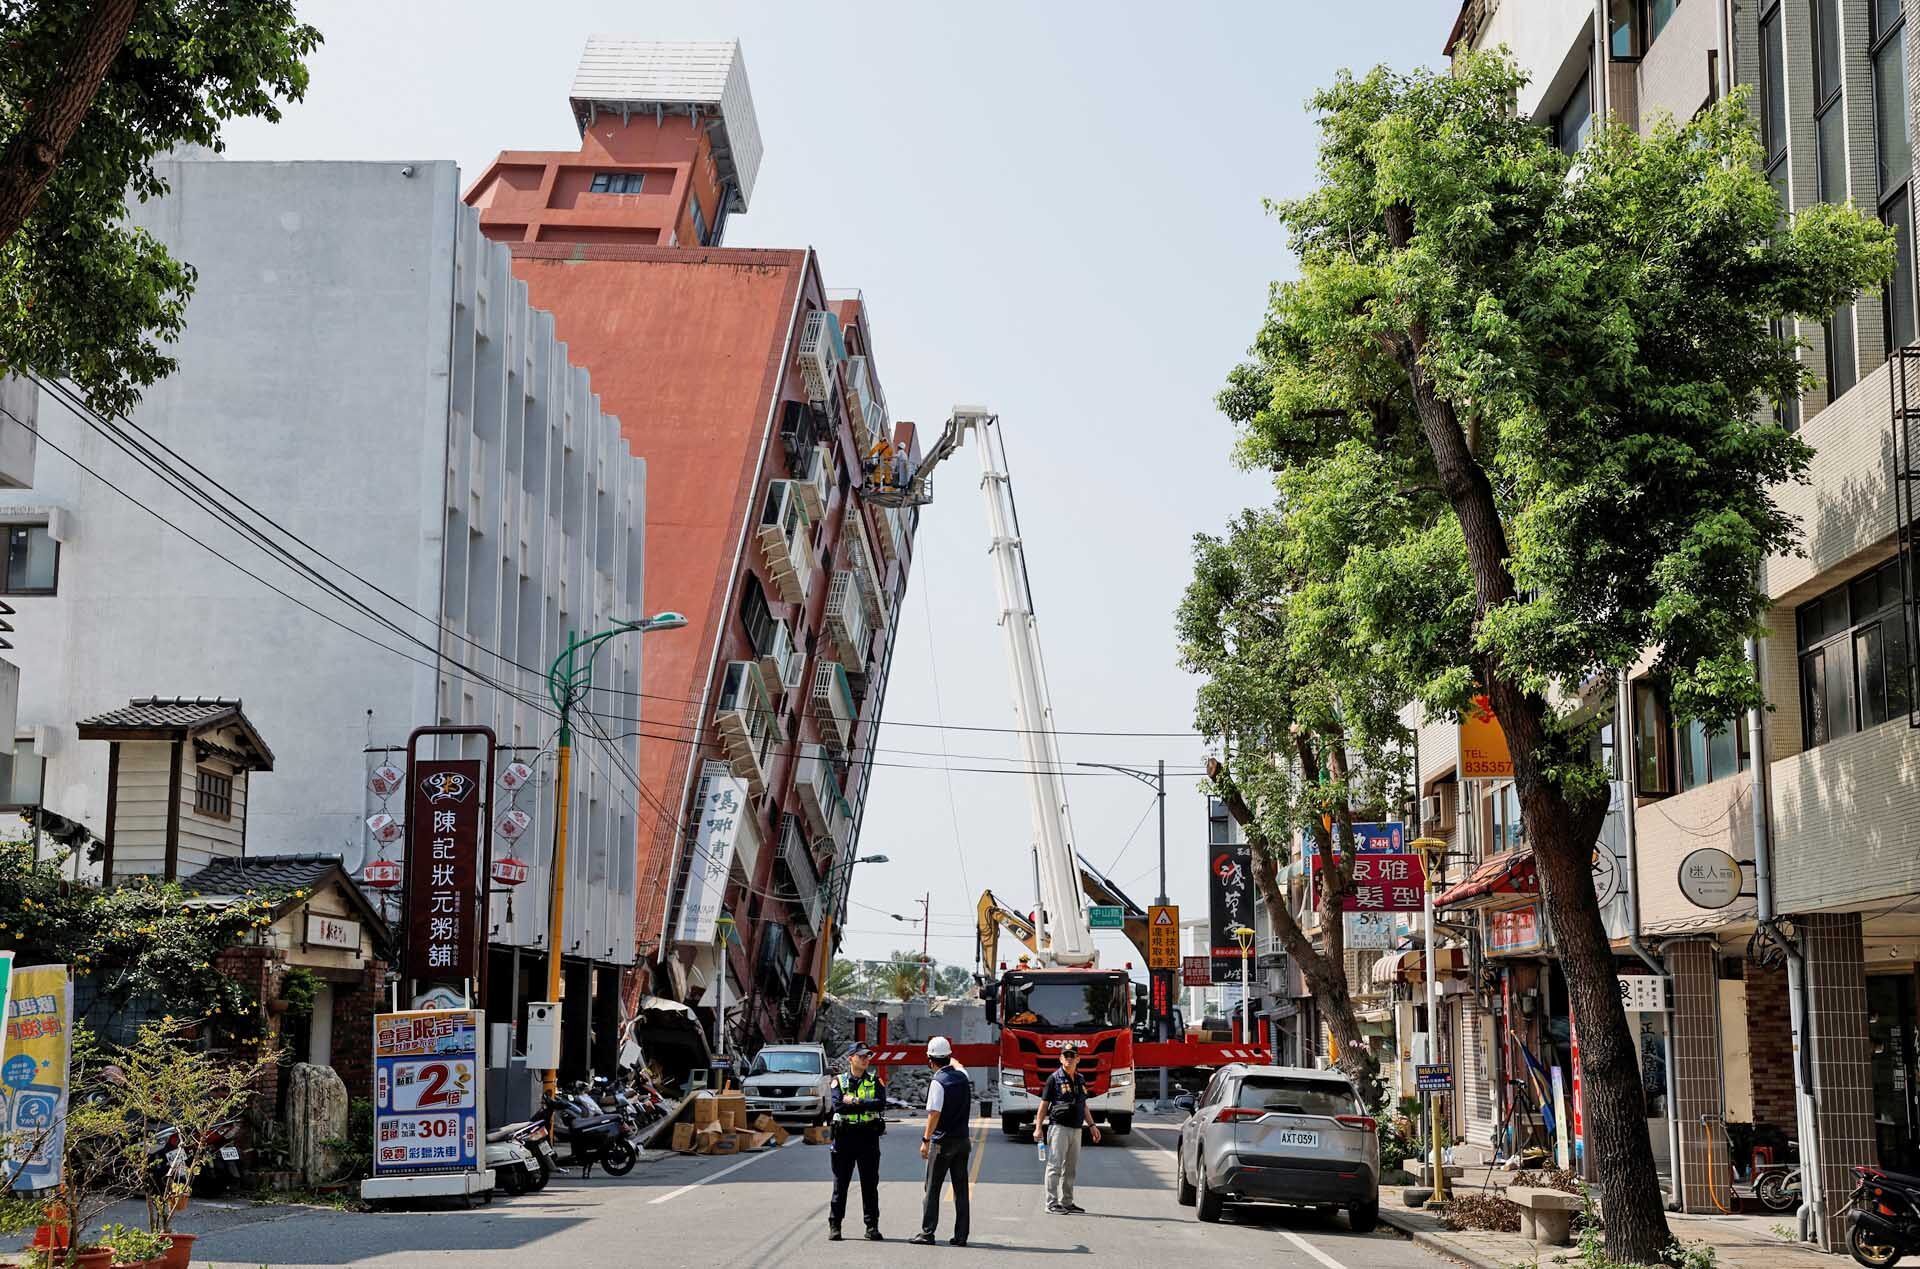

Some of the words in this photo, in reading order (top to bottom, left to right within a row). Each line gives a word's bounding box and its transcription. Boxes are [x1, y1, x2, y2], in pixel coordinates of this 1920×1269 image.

[1464, 750, 1488, 759] TEL:
[1371, 838, 1389, 848] 24H
[1355, 886, 1420, 908] 髮型
[418, 1119, 448, 1138] 30
